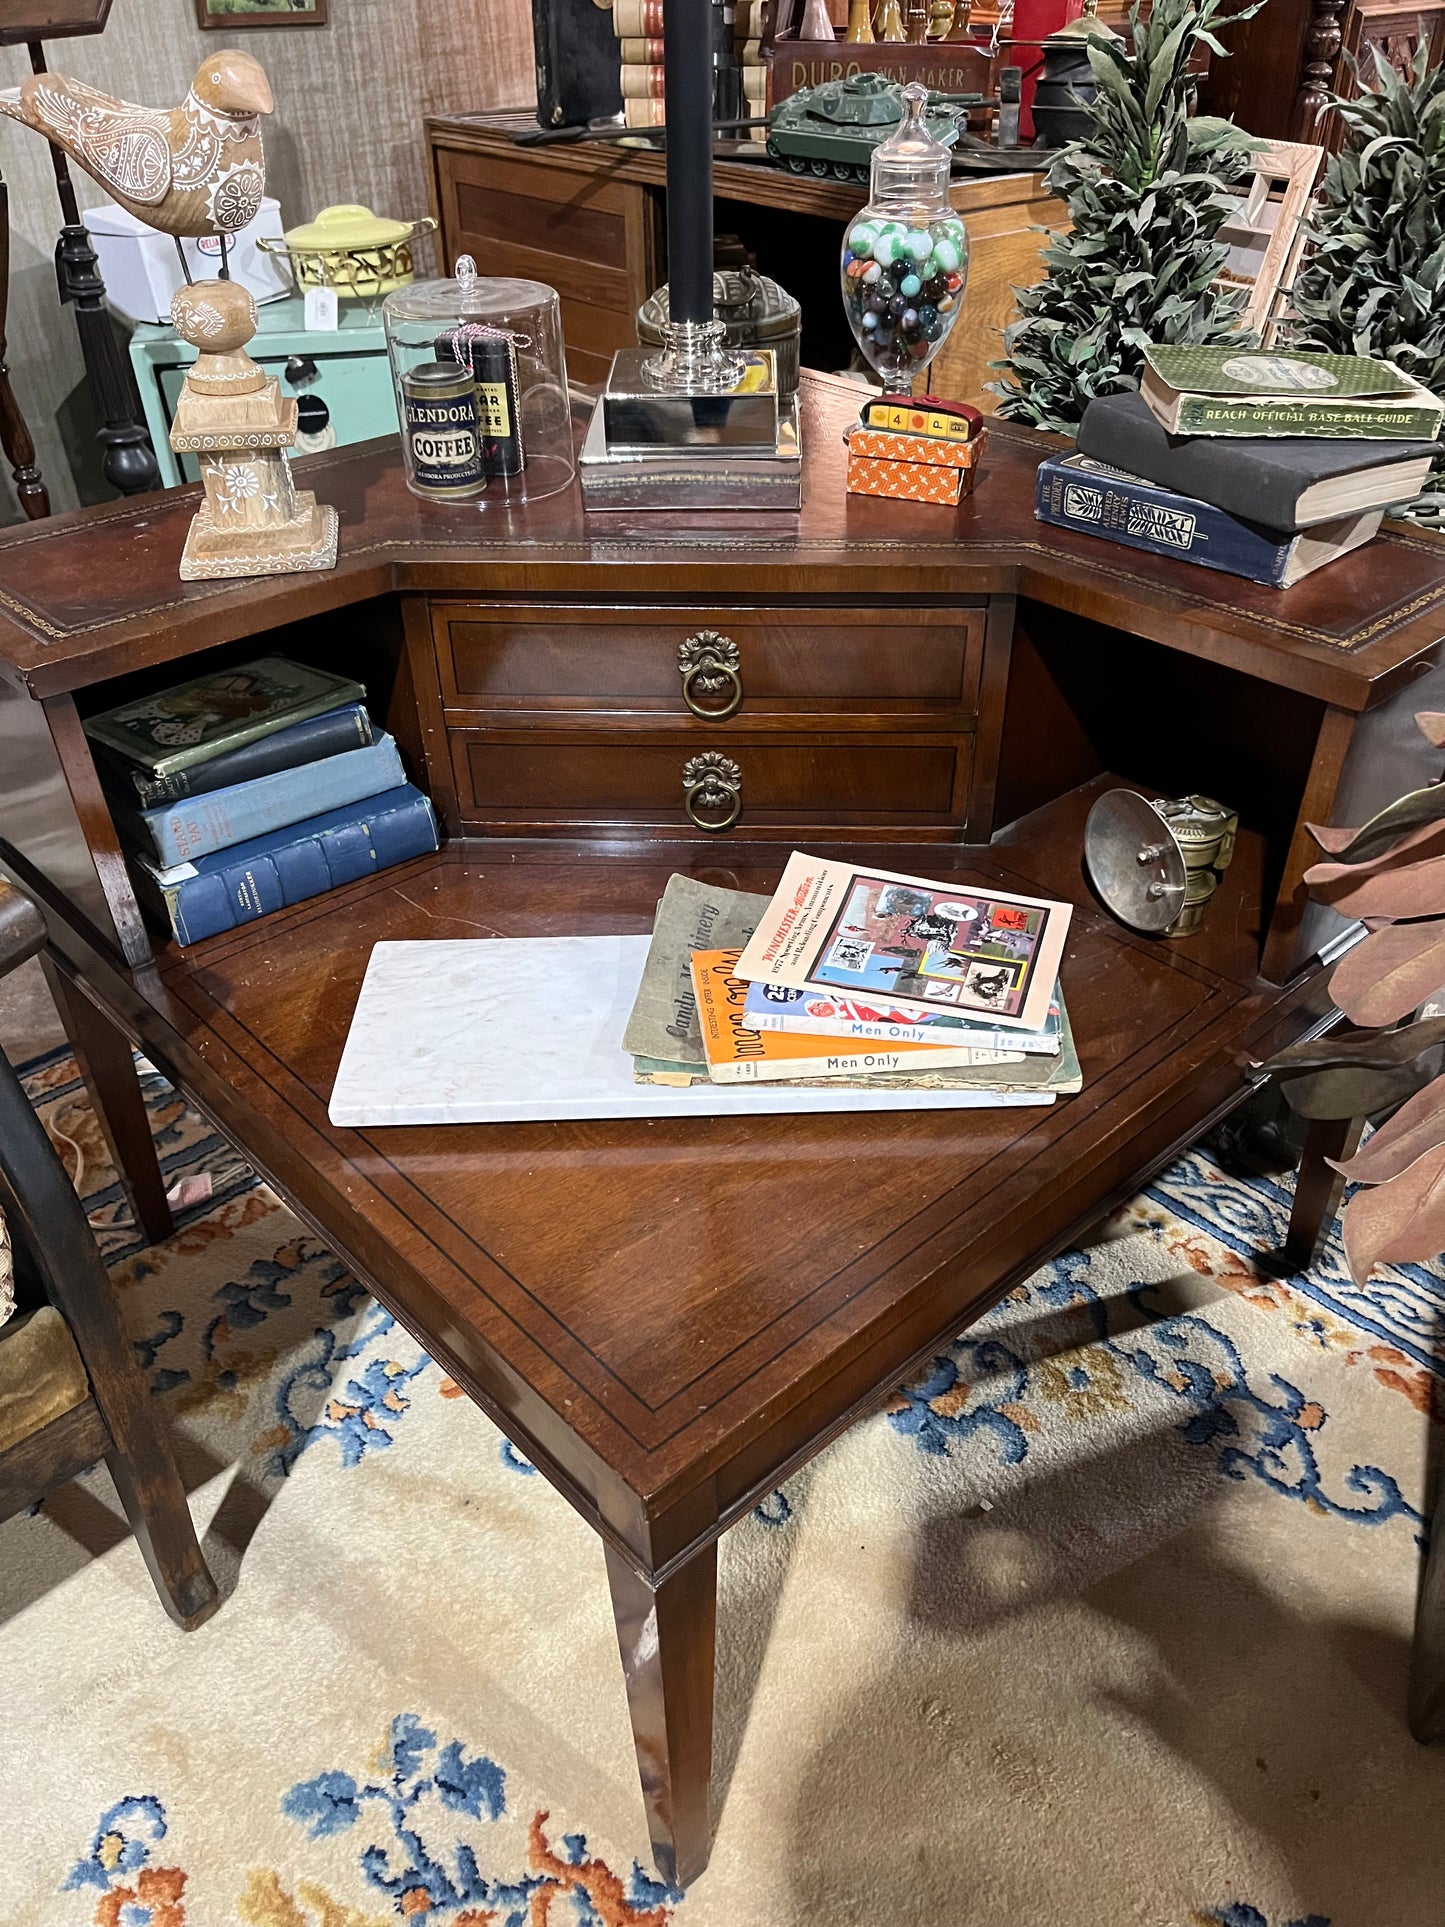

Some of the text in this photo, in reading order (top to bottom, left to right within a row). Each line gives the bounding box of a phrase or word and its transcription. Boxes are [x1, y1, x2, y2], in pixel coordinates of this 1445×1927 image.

[406, 401, 475, 423] GLENDORA
[893, 414, 902, 425] 4
[1206, 409, 1414, 424] REACH OFFICIAL BASE BALL GUIDE
[415, 436, 473, 458] COFFEE
[1042, 484, 1051, 503] THE
[1050, 474, 1064, 517] PRESIDENT
[1102, 490, 1114, 529] ALFRED
[1110, 493, 1121, 529] HENRY
[1118, 496, 1129, 531] LEWIS
[170, 816, 190, 856] STAND
[185, 821, 202, 843] PAT
[771, 959, 784, 973] 1977
[779, 931, 801, 958] Sporting
[804, 869, 829, 911] Ammunition
[790, 883, 835, 966] and Reloading Components
[767, 983, 786, 1001] 25
[701, 968, 720, 1039] INTERESTING OFFER INSIDE
[851, 1023, 925, 1041] Men Only
[827, 1054, 900, 1069] Men Only
